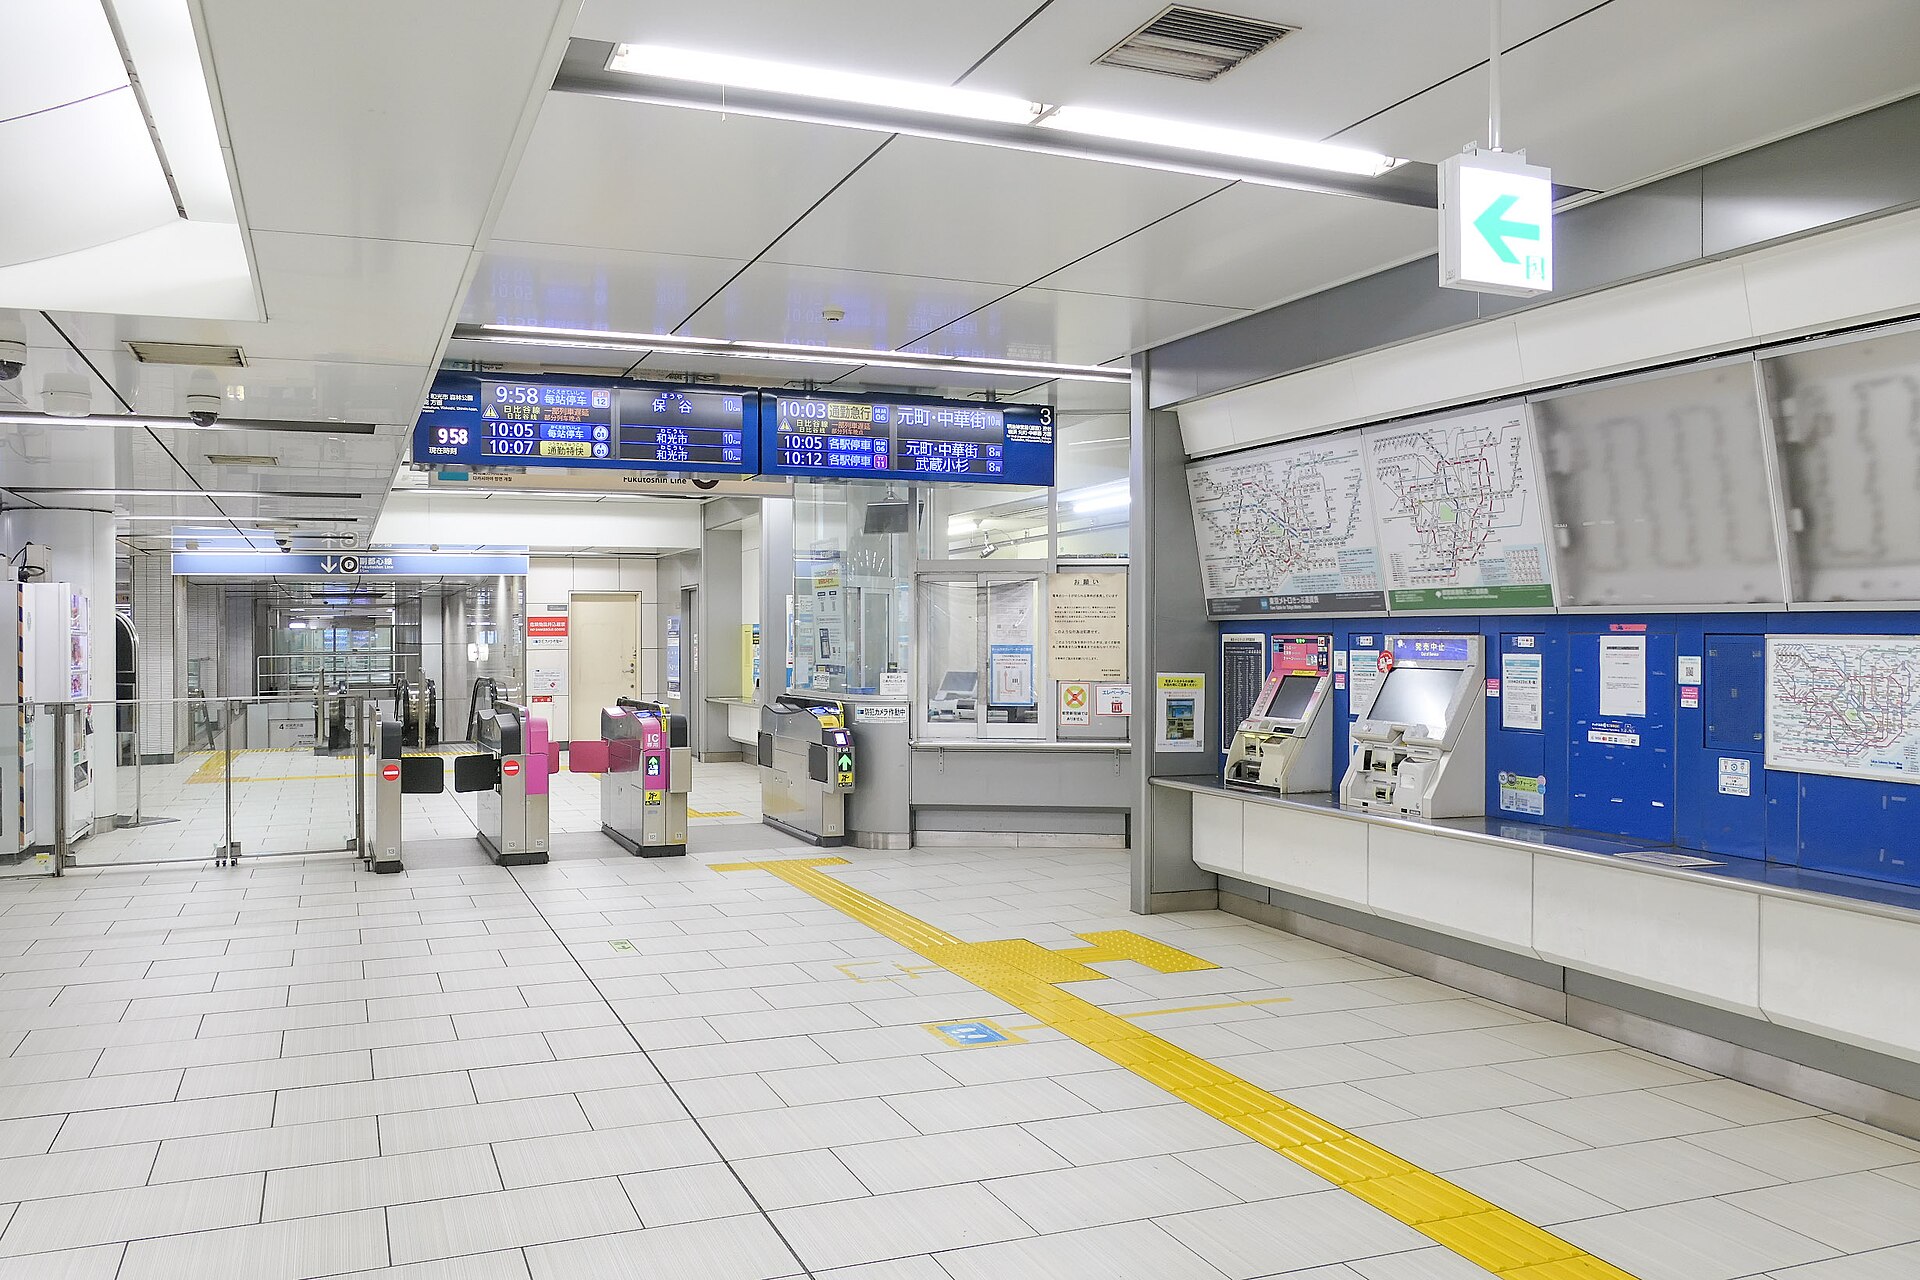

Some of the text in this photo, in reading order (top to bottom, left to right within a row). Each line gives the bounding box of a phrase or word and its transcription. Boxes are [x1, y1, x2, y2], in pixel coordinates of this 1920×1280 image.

[496, 386, 538, 404] 9:58
[504, 405, 540, 414] 日比谷線
[780, 401, 871, 420] 10:03 通勤急行
[1040, 408, 1051, 426] 3
[898, 408, 986, 430] 元町・中華街
[490, 422, 534, 437] 10:05
[656, 433, 688, 445] 和光市
[784, 436, 871, 451] 10:05 各駅停車
[490, 440, 534, 454] 10:07
[906, 441, 978, 458] 元町・中華街
[656, 450, 688, 461] 和光市
[784, 452, 871, 467] 10:12 各駅停車
[916, 458, 969, 473] 武蔵小杉
[1415, 642, 1445, 651] 発売中止
[648, 734, 659, 742] IC
